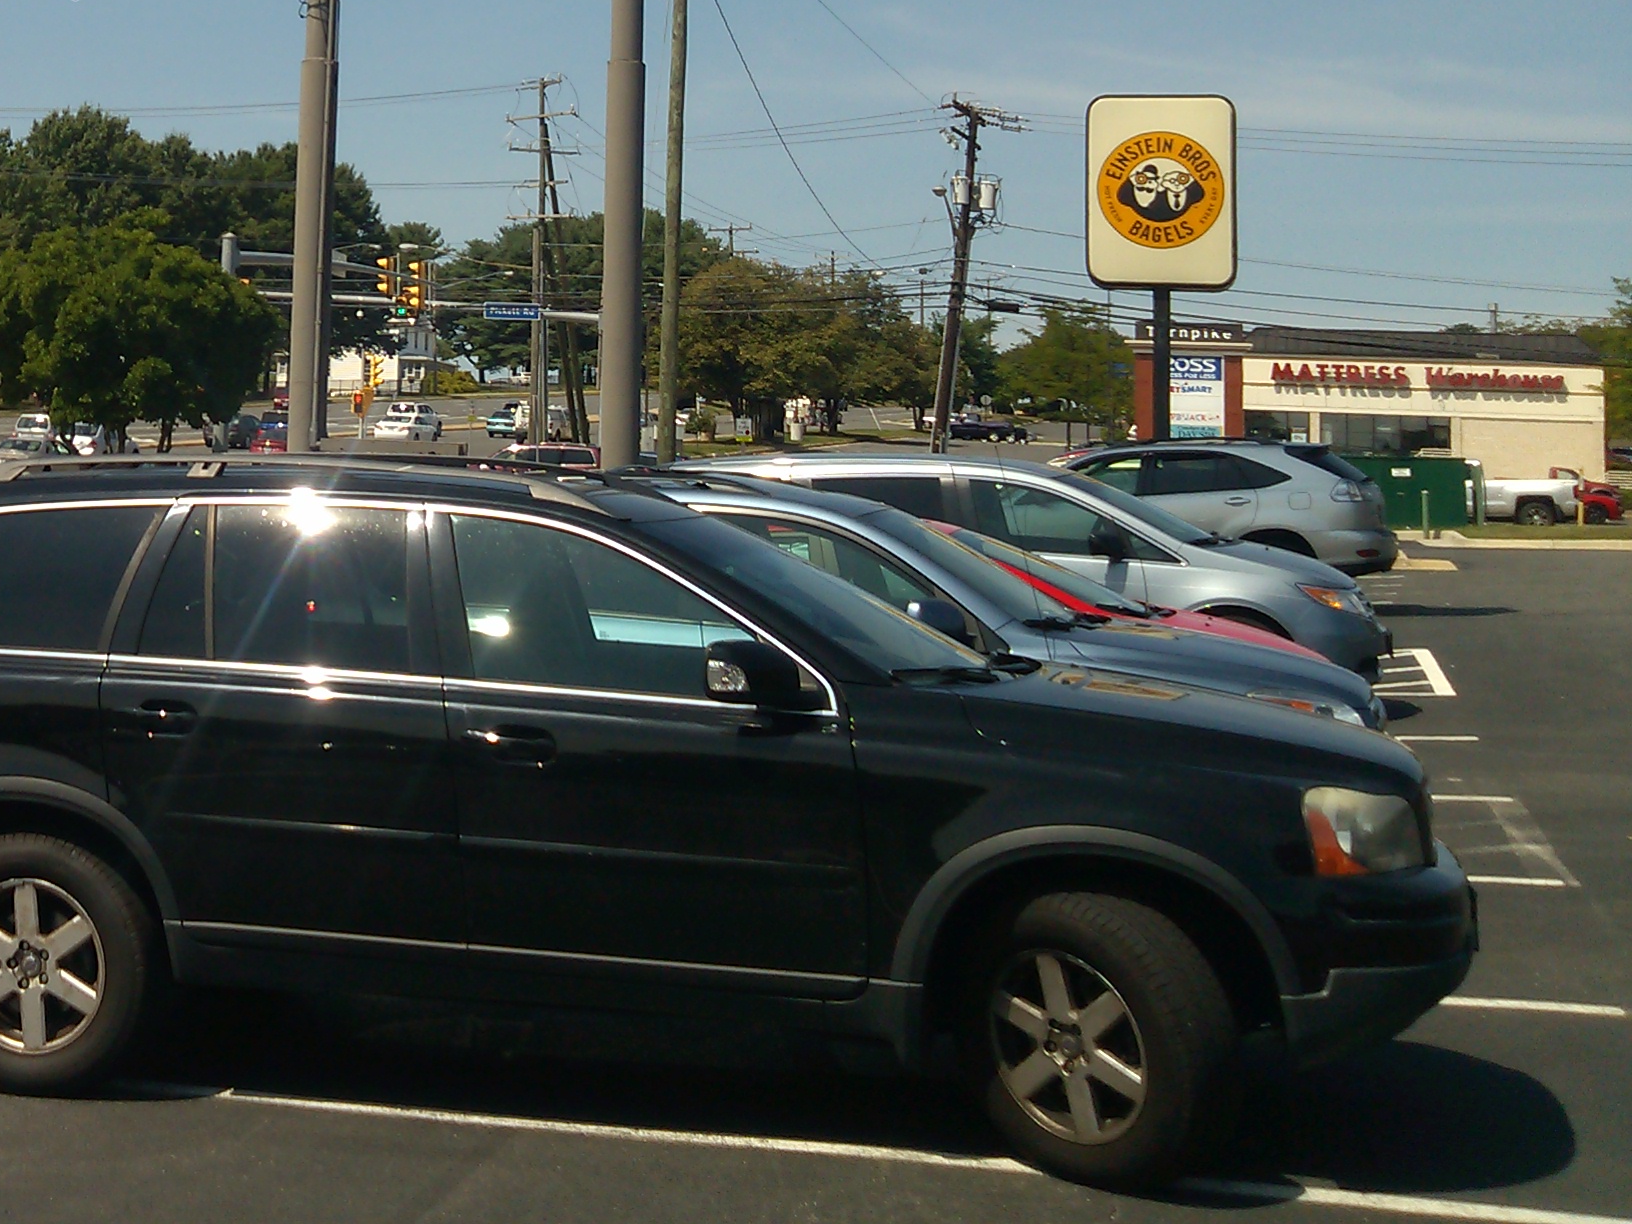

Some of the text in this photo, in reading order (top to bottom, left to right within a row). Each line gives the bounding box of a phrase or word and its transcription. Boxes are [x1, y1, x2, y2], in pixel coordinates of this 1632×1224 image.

[1106, 137, 1216, 182] EINSTEIN BROS
[1128, 220, 1194, 244] BAGELS
[1145, 325, 1232, 341] Trnpike
[1270, 362, 1565, 390] MATTRESS Warehouse
